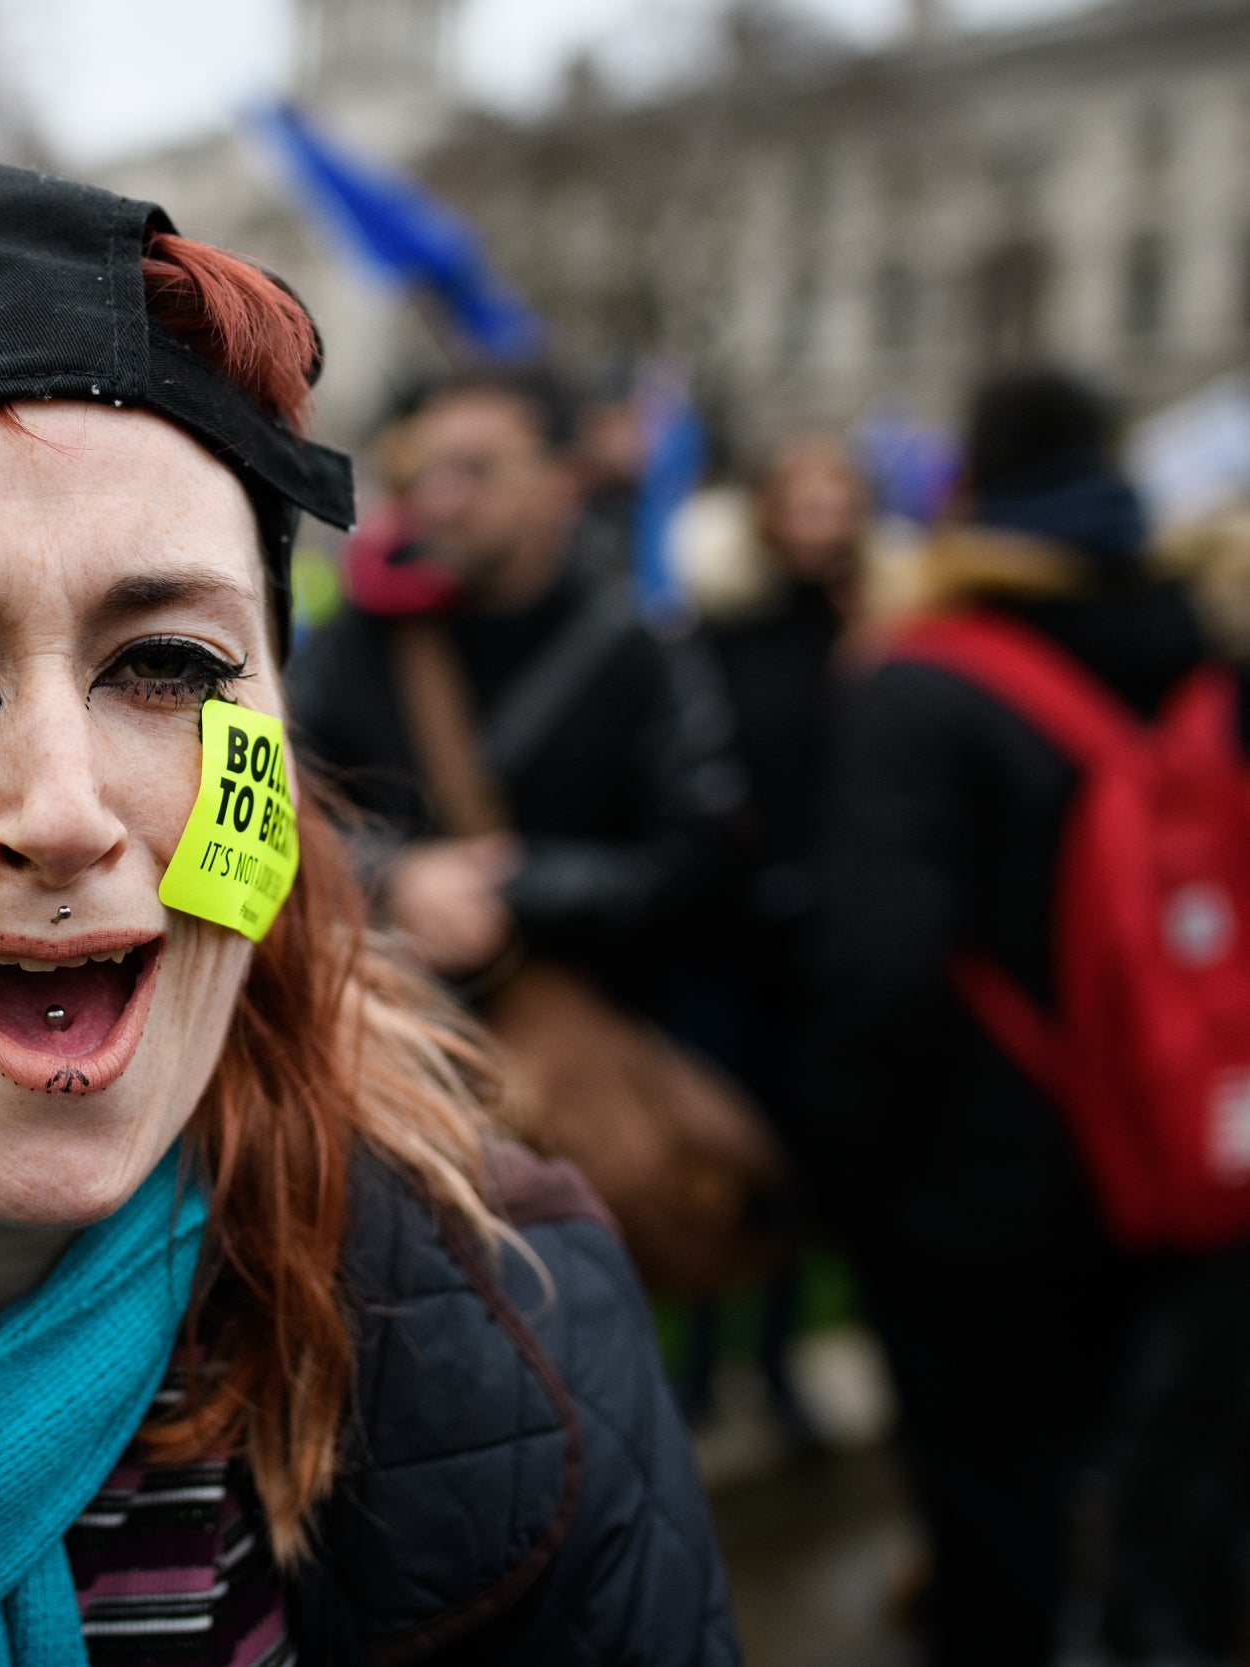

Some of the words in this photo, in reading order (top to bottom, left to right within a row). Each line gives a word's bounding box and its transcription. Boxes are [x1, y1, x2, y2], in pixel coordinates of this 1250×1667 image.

[216, 777, 254, 833] TO
[200, 841, 233, 876] IT'S
[234, 851, 258, 885] NOT
